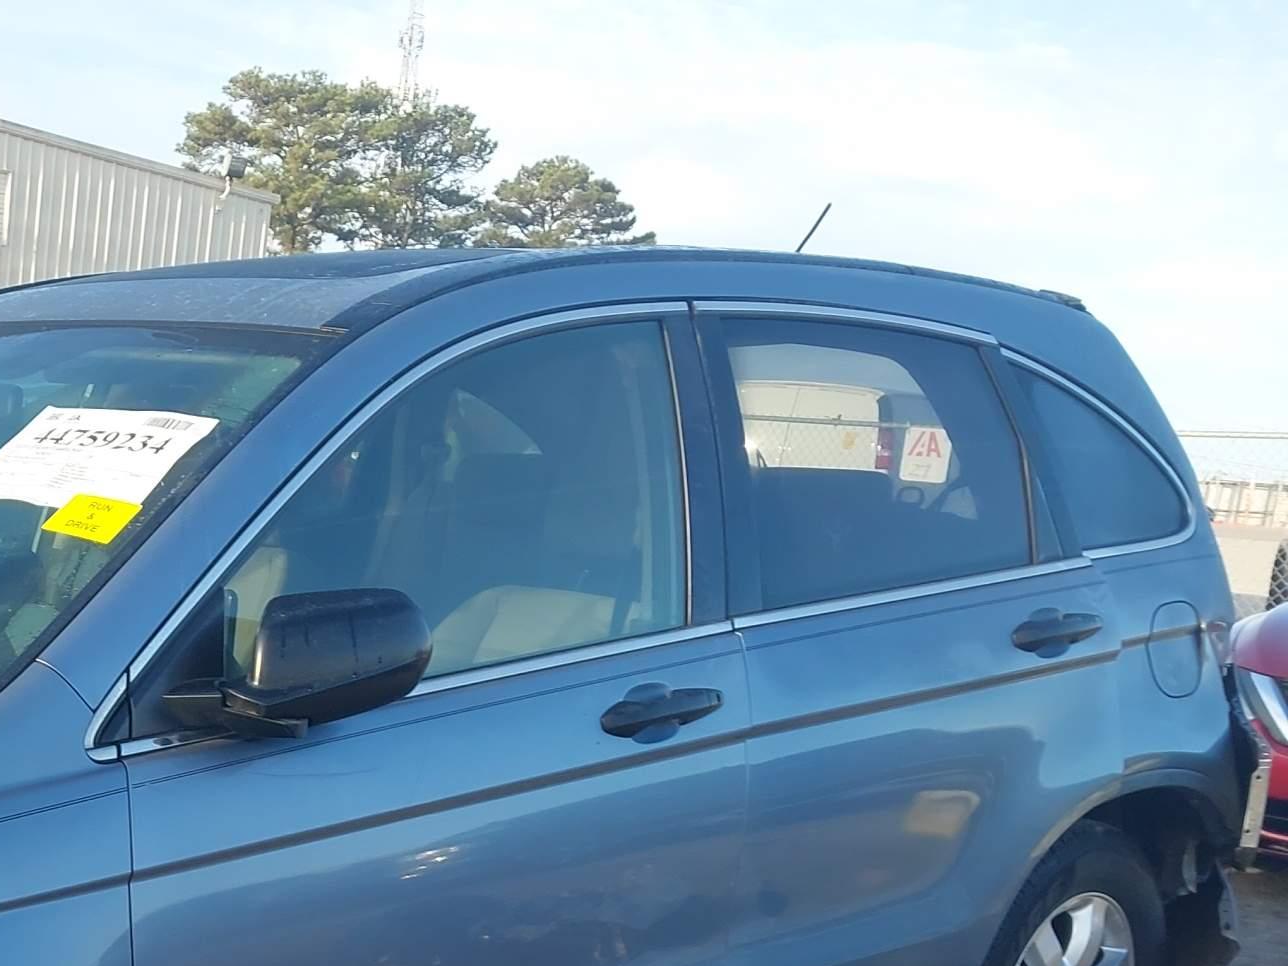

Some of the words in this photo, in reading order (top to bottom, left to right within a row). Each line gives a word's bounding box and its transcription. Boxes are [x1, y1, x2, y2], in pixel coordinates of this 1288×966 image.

[34, 428, 173, 454] 44759234
[88, 502, 114, 512] RUN
[65, 519, 101, 533] DRIVE
